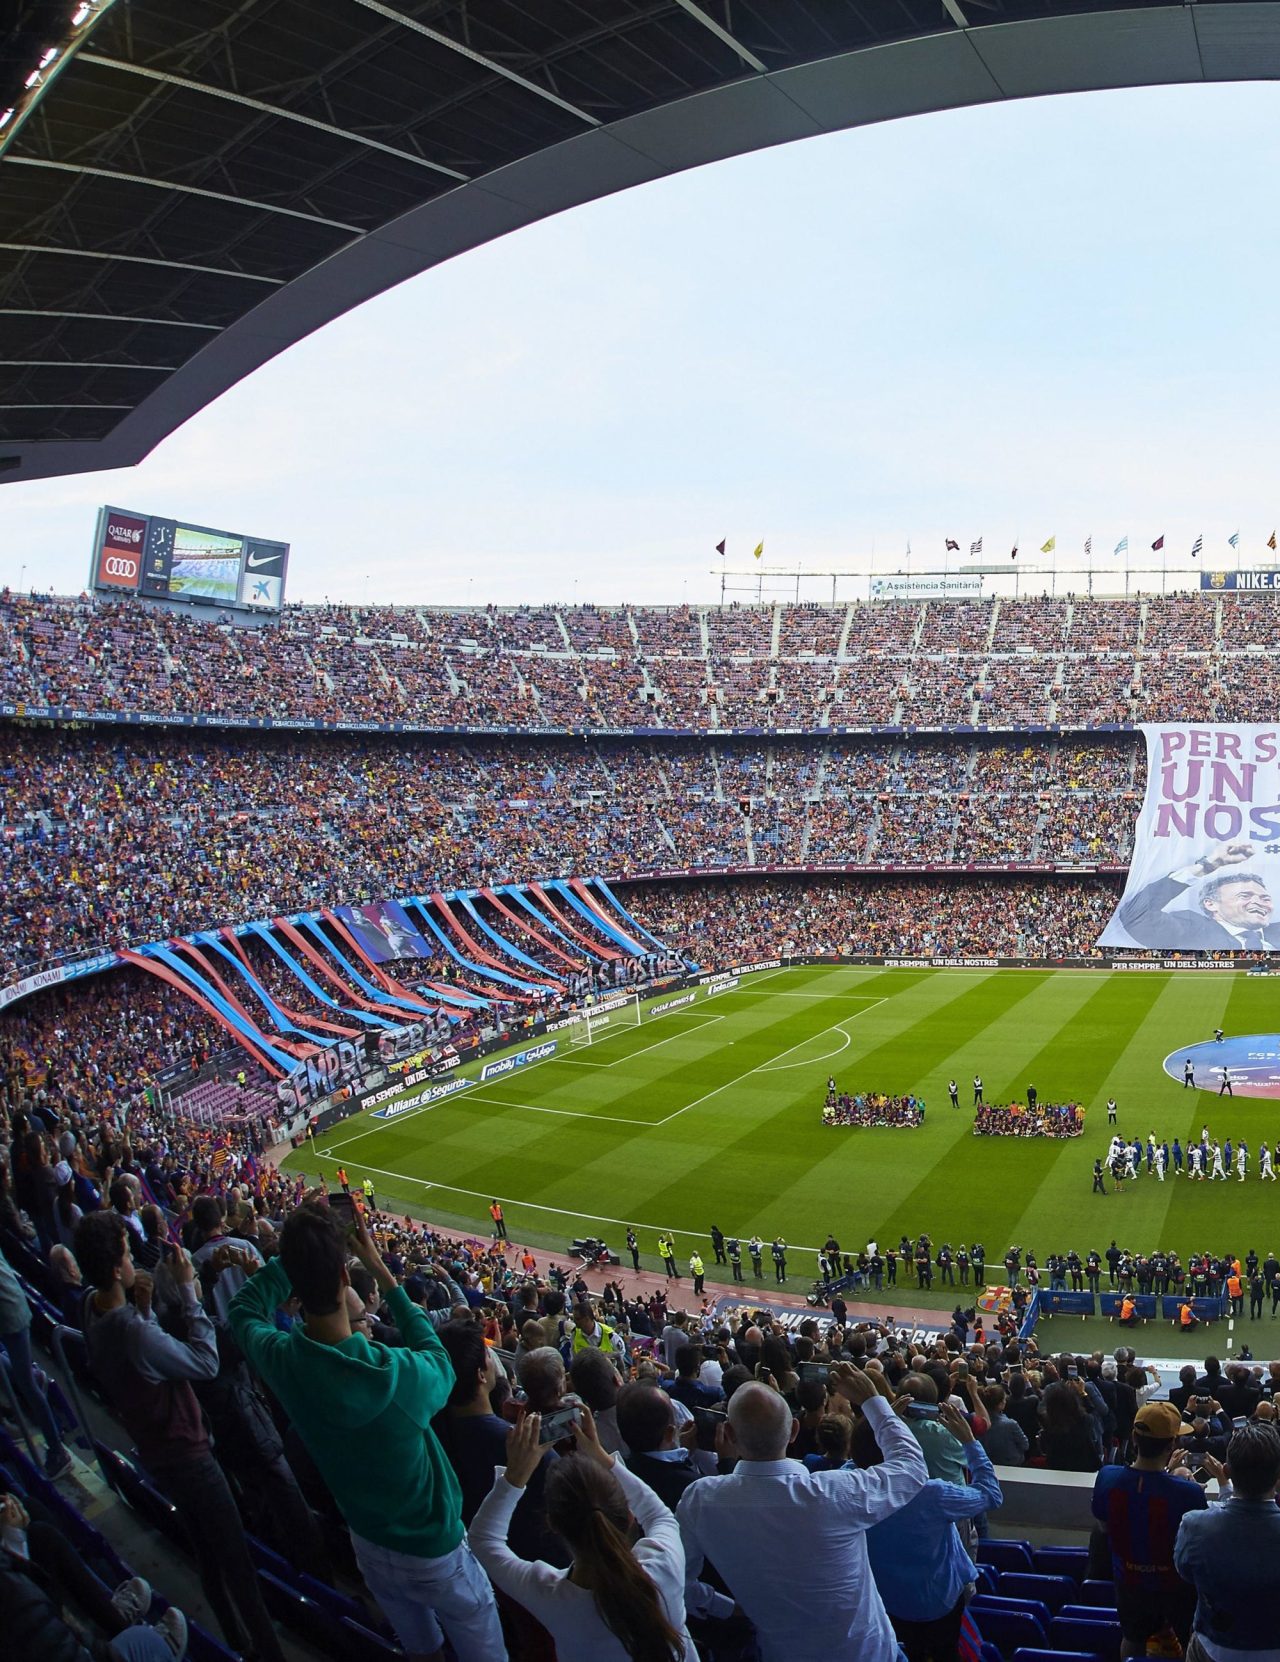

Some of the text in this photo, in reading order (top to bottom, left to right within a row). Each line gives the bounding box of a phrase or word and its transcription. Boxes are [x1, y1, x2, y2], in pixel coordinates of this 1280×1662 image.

[108, 525, 132, 538] QATAR
[1160, 730, 1243, 763] PER
[1161, 760, 1257, 803] UN
[614, 949, 687, 987] NOSTRES
[884, 959, 899, 967] PER
[1112, 962, 1127, 970] PER
[33, 969, 61, 988] KONAMI
[651, 1002, 669, 1015] QATAR
[487, 1058, 515, 1076] mobily
[361, 1093, 377, 1110] PER
[404, 1076, 417, 1086] UN
[385, 1079, 466, 1117] Allianz Seguros
